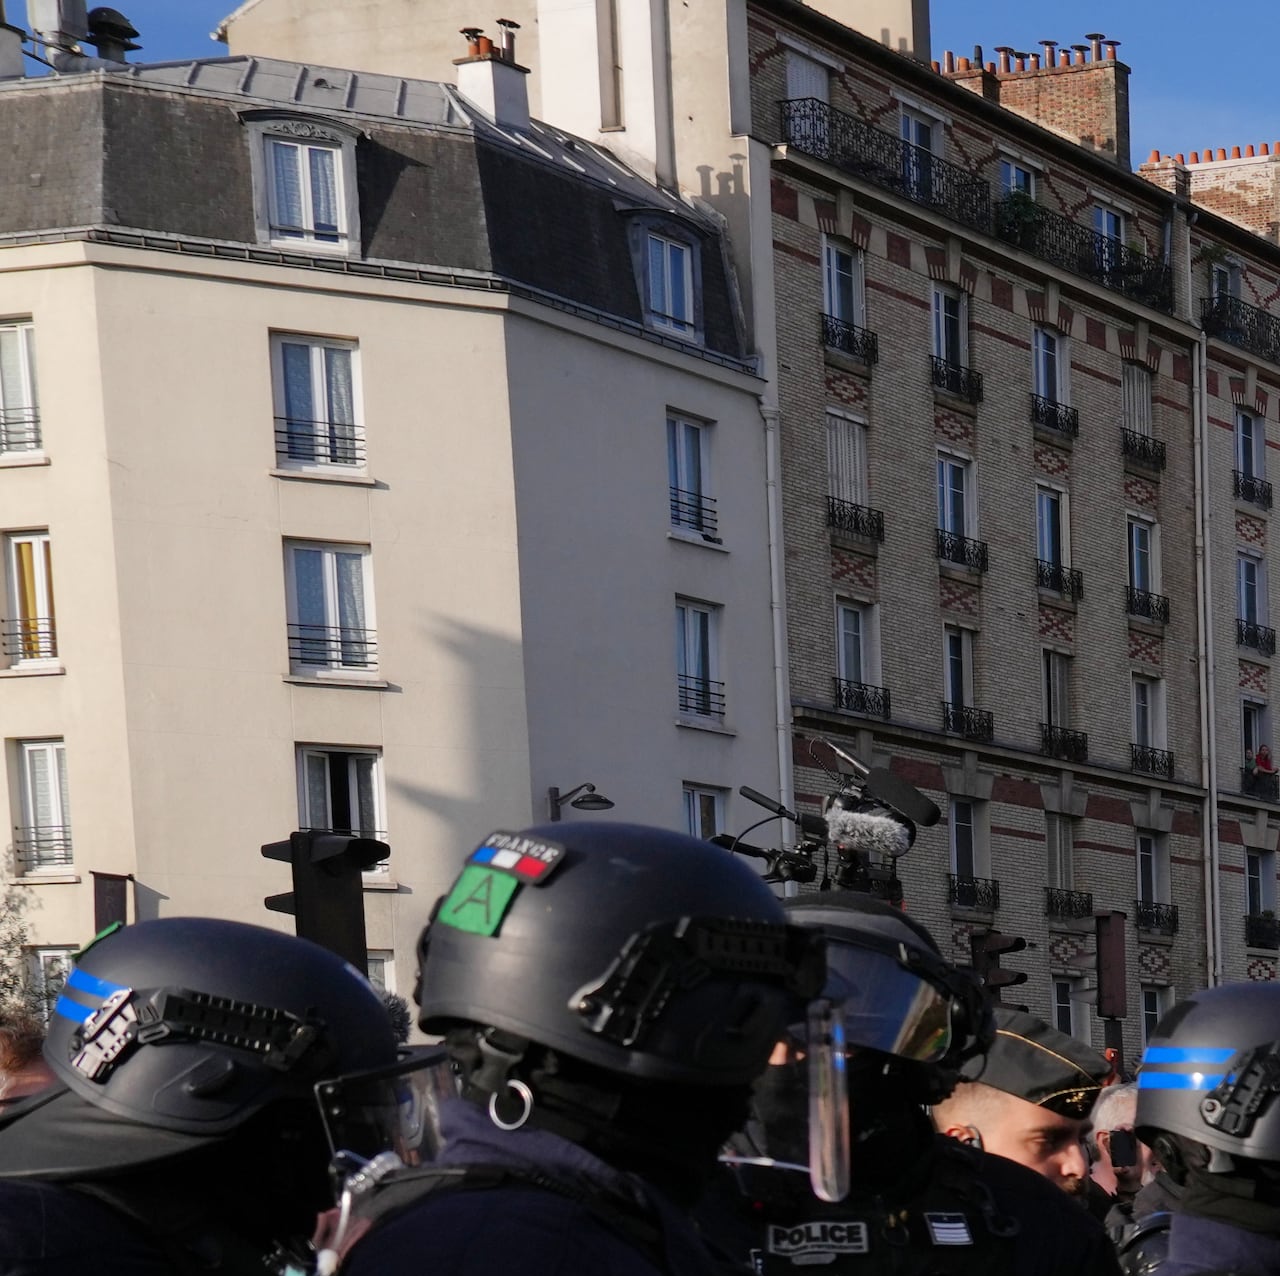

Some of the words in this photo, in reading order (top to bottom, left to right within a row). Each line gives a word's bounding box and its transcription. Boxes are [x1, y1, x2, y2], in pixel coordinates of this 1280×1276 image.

[485, 833, 559, 863] FRANCE
[452, 873, 494, 925] A
[773, 1225, 863, 1245] POLICE
